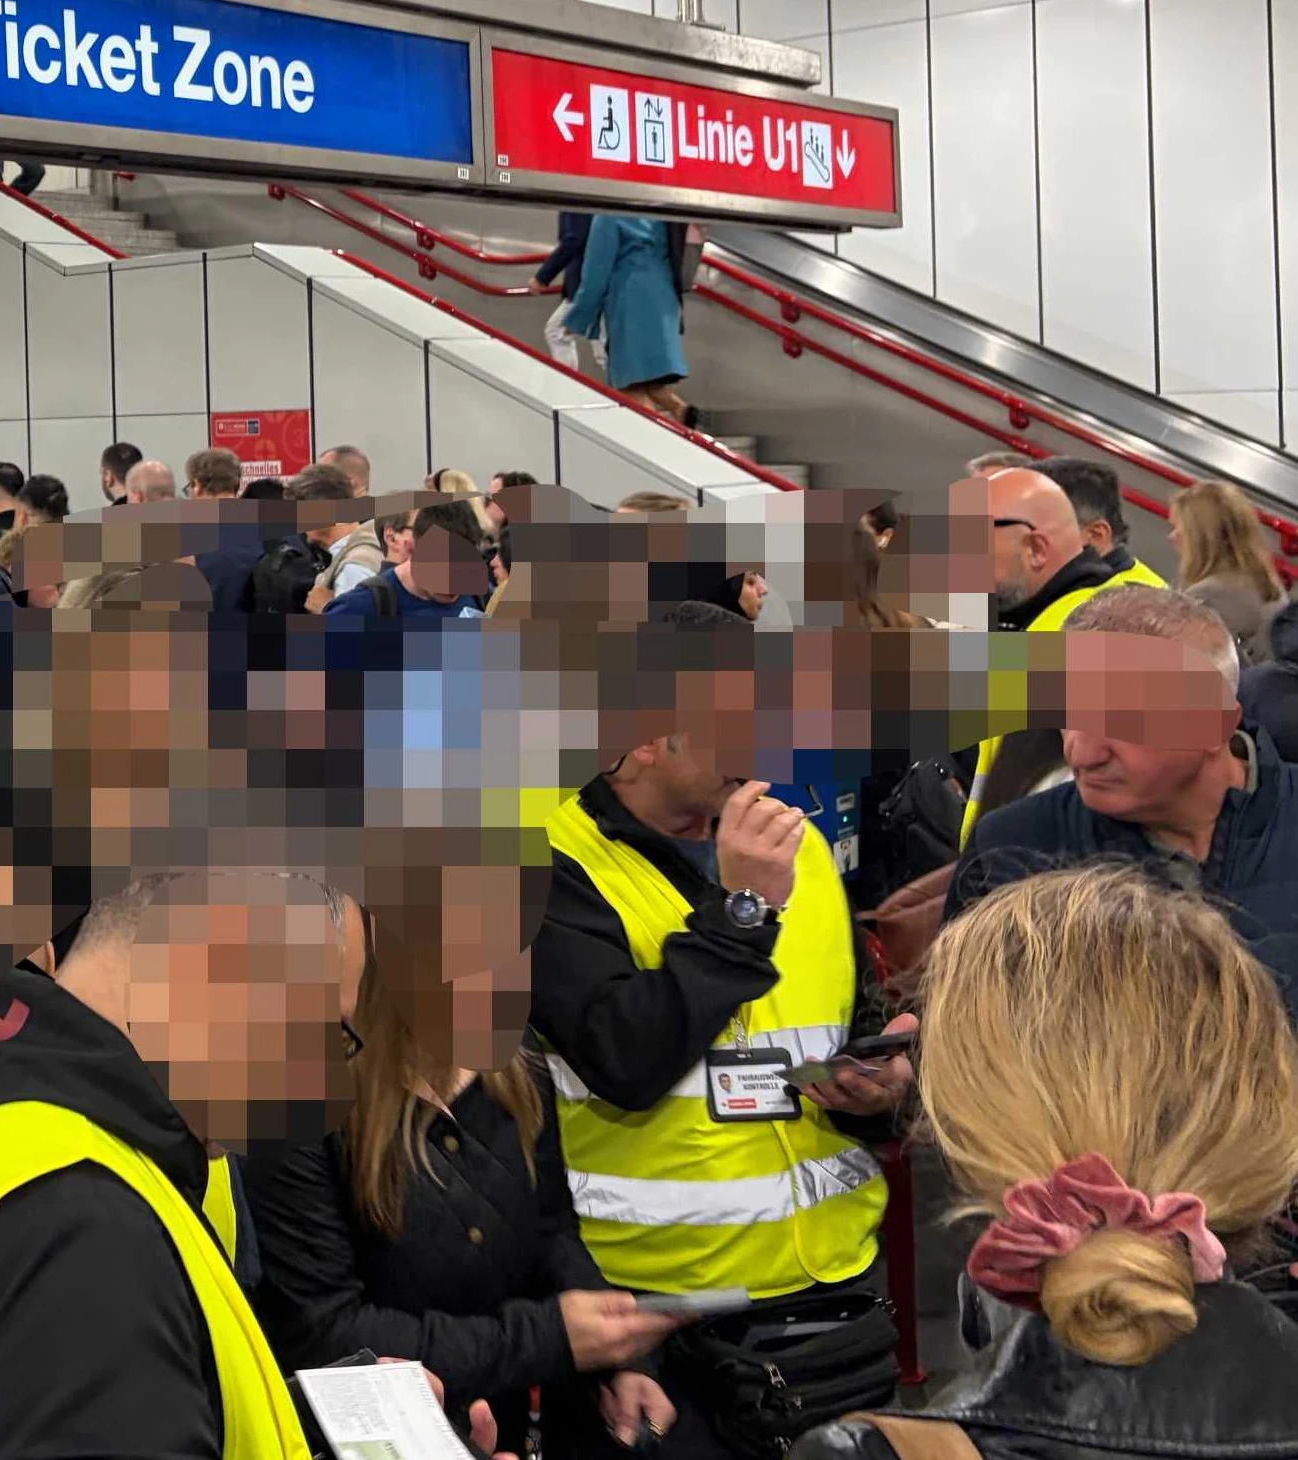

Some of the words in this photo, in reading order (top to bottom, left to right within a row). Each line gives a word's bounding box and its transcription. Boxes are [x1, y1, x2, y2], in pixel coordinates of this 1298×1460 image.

[173, 25, 315, 113] Zone
[677, 101, 754, 167] Linie
[762, 116, 799, 174] U1
